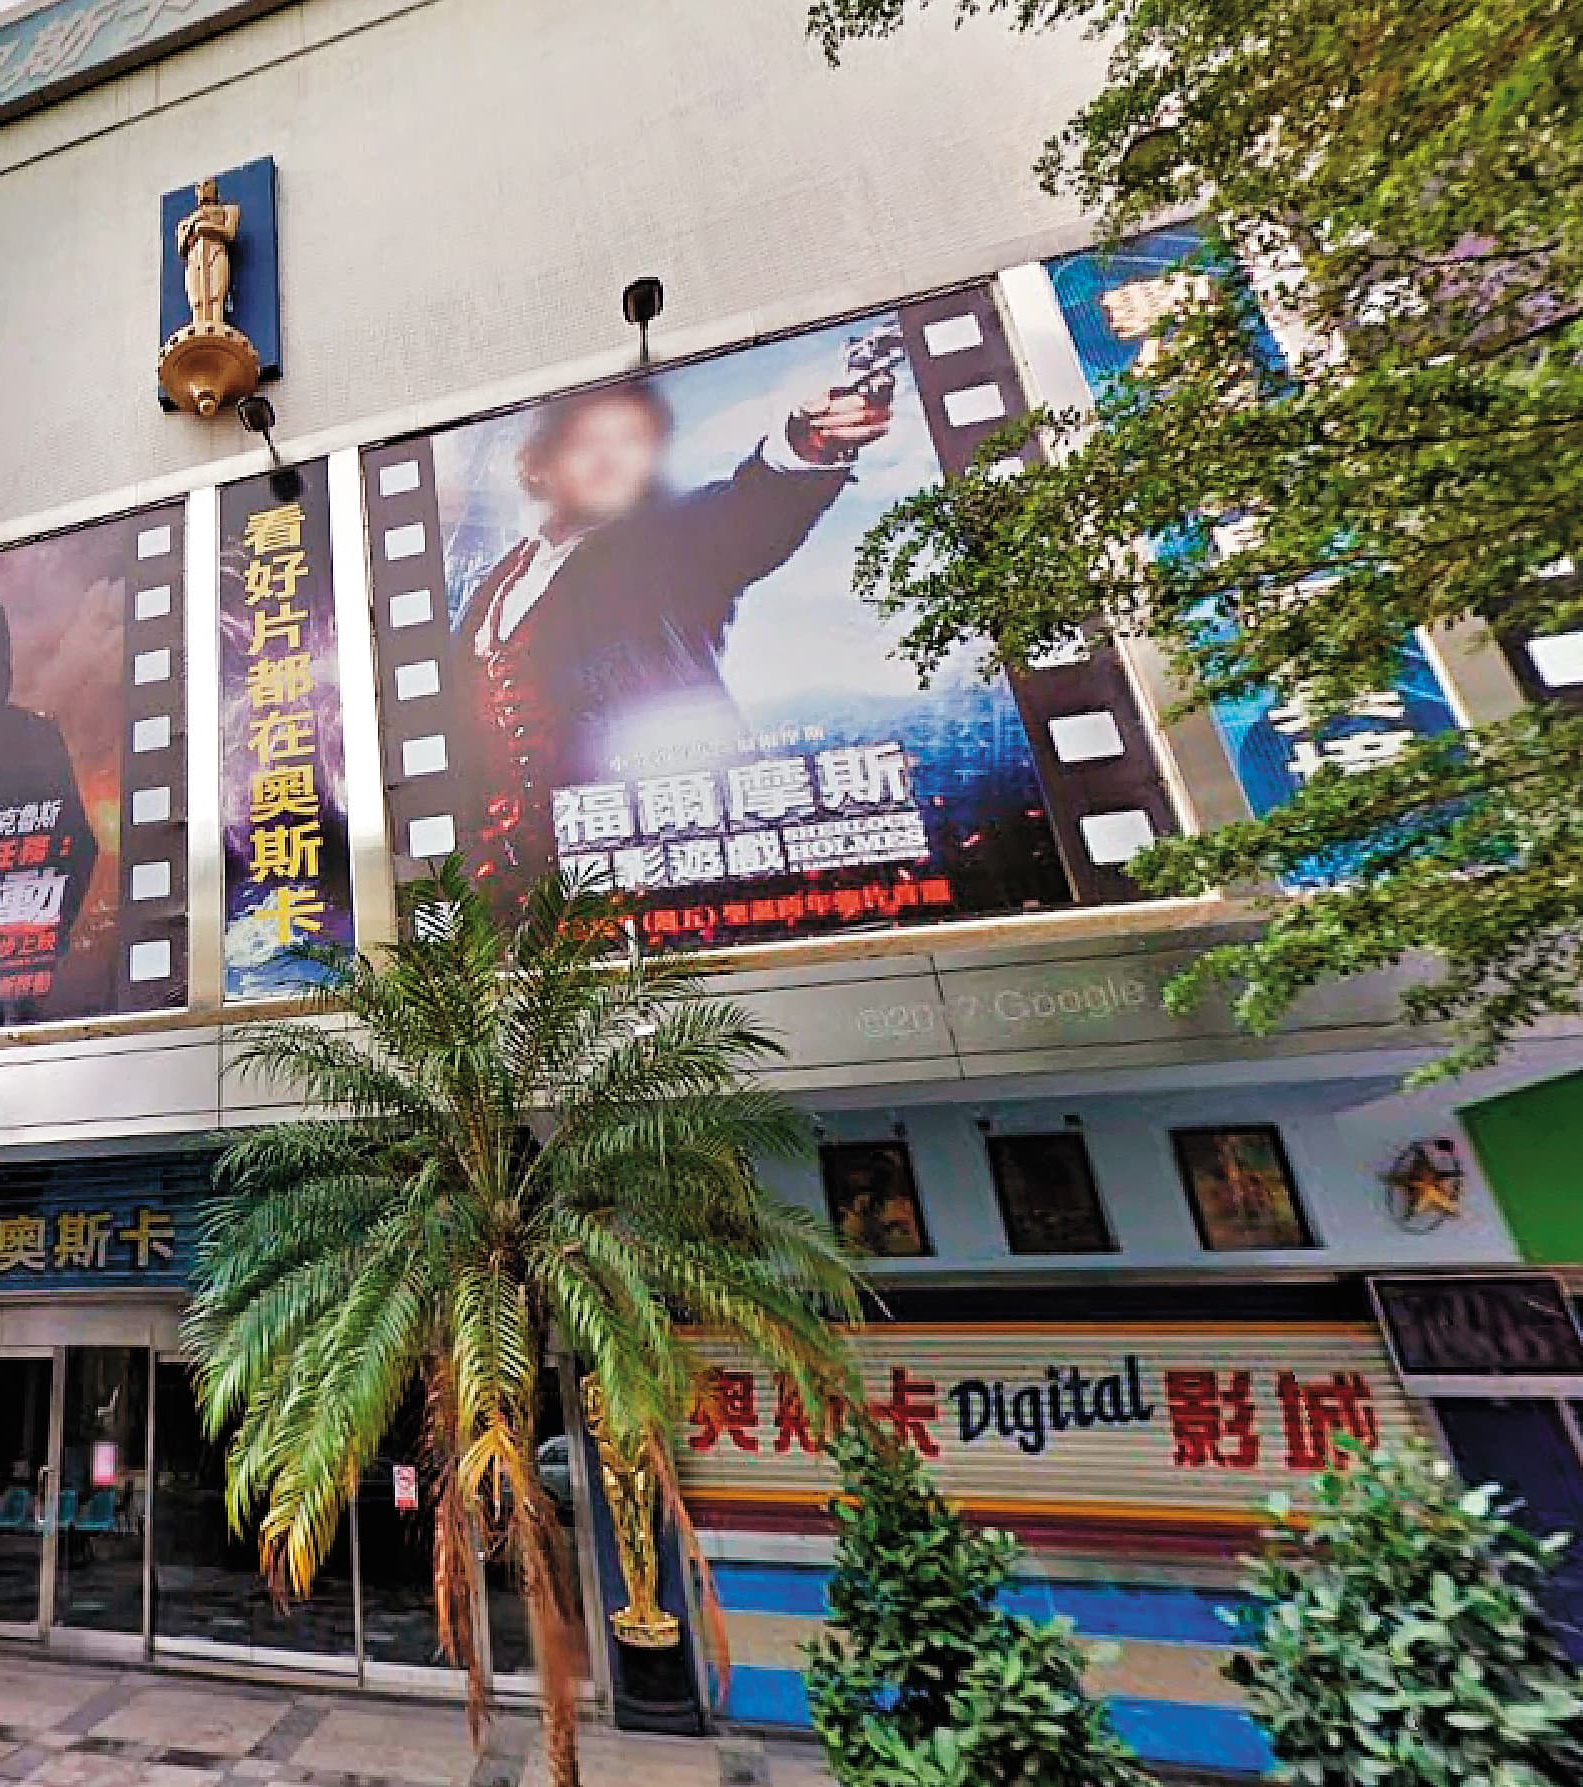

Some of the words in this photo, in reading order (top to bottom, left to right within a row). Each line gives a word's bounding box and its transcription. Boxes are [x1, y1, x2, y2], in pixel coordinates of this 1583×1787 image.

[243, 503, 325, 946] 看好片都在奧斯卡
[552, 741, 912, 846] 福爾摩斯
[948, 1354, 1154, 1456] Digital
[1164, 1368, 1380, 1470] 影城
